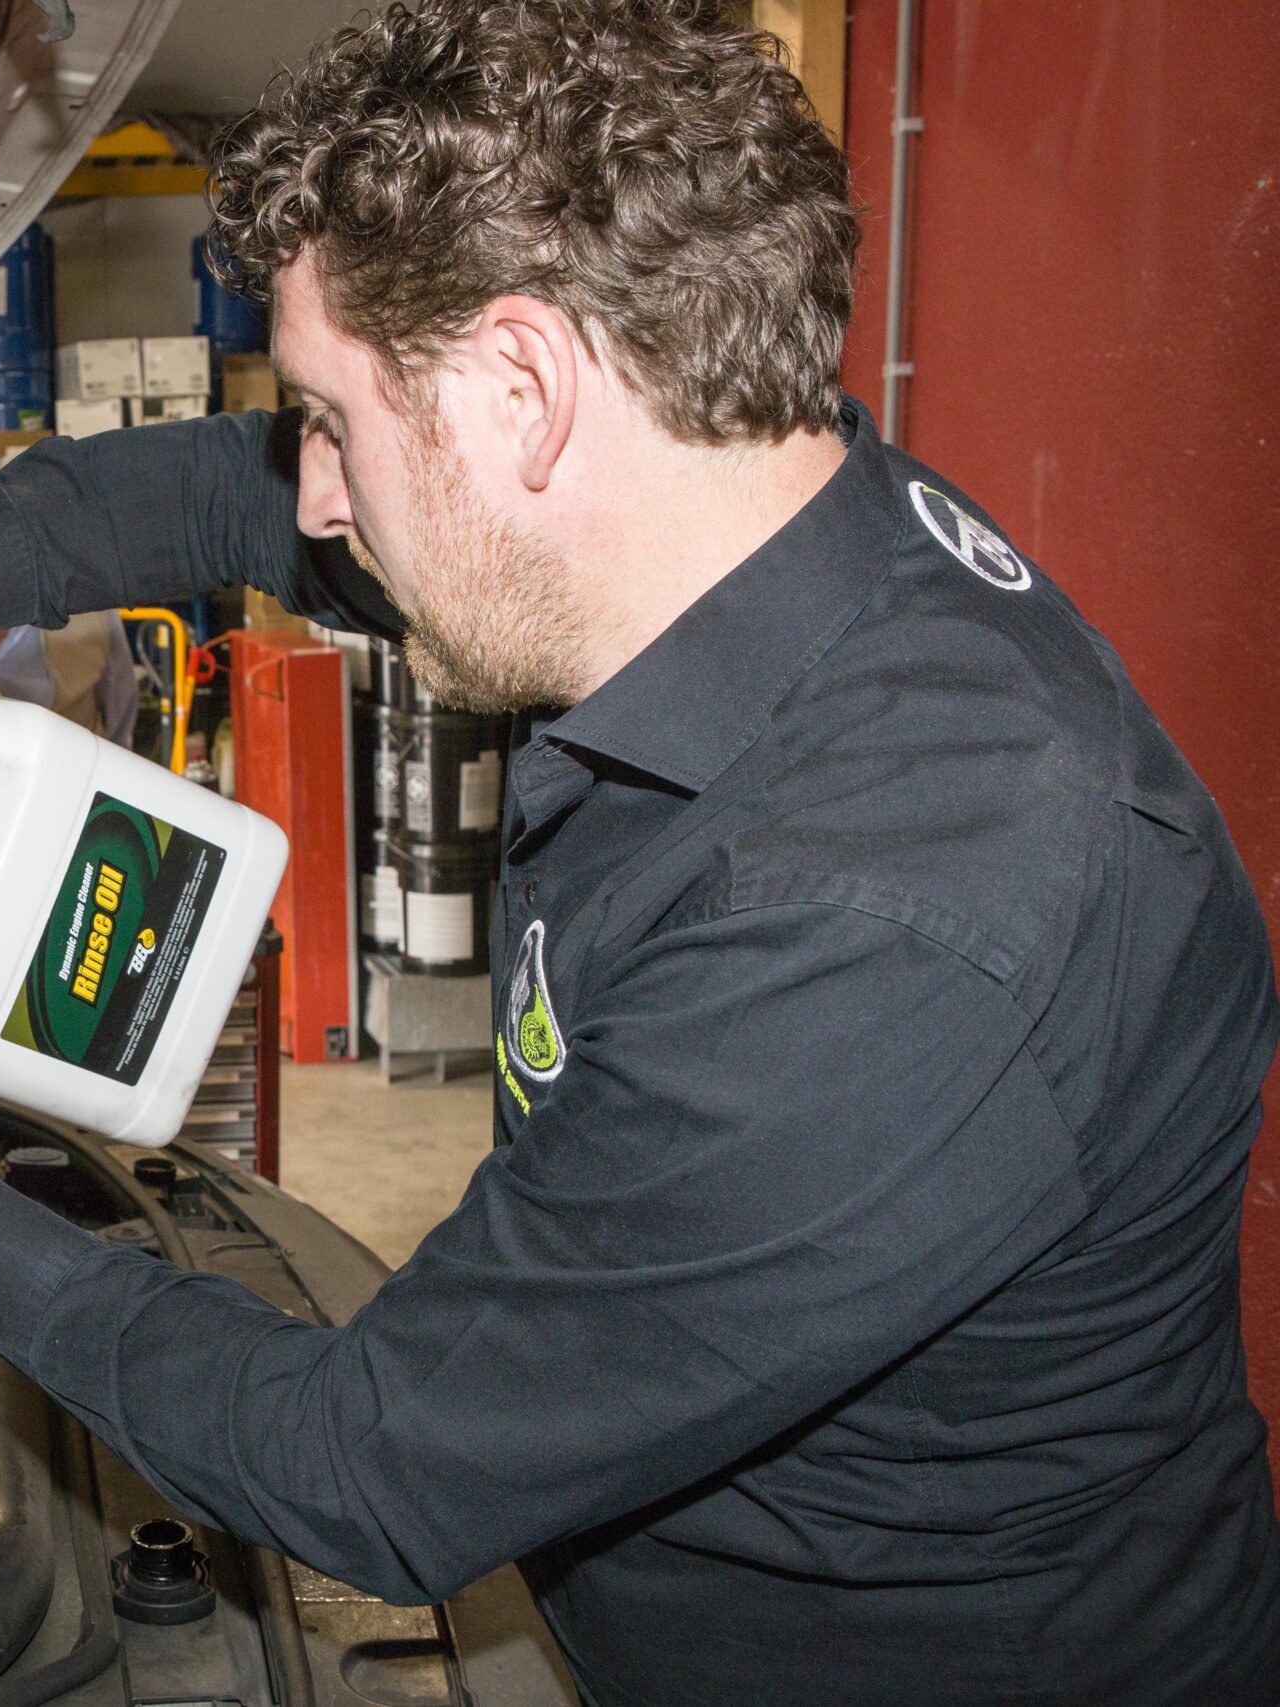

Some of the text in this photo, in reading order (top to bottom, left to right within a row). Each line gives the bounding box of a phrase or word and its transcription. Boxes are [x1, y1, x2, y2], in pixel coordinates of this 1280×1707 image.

[59, 863, 93, 980] Dynamic Engine Cleaner
[74, 865, 123, 1001] Rinse Oil
[127, 943, 155, 974] BG
